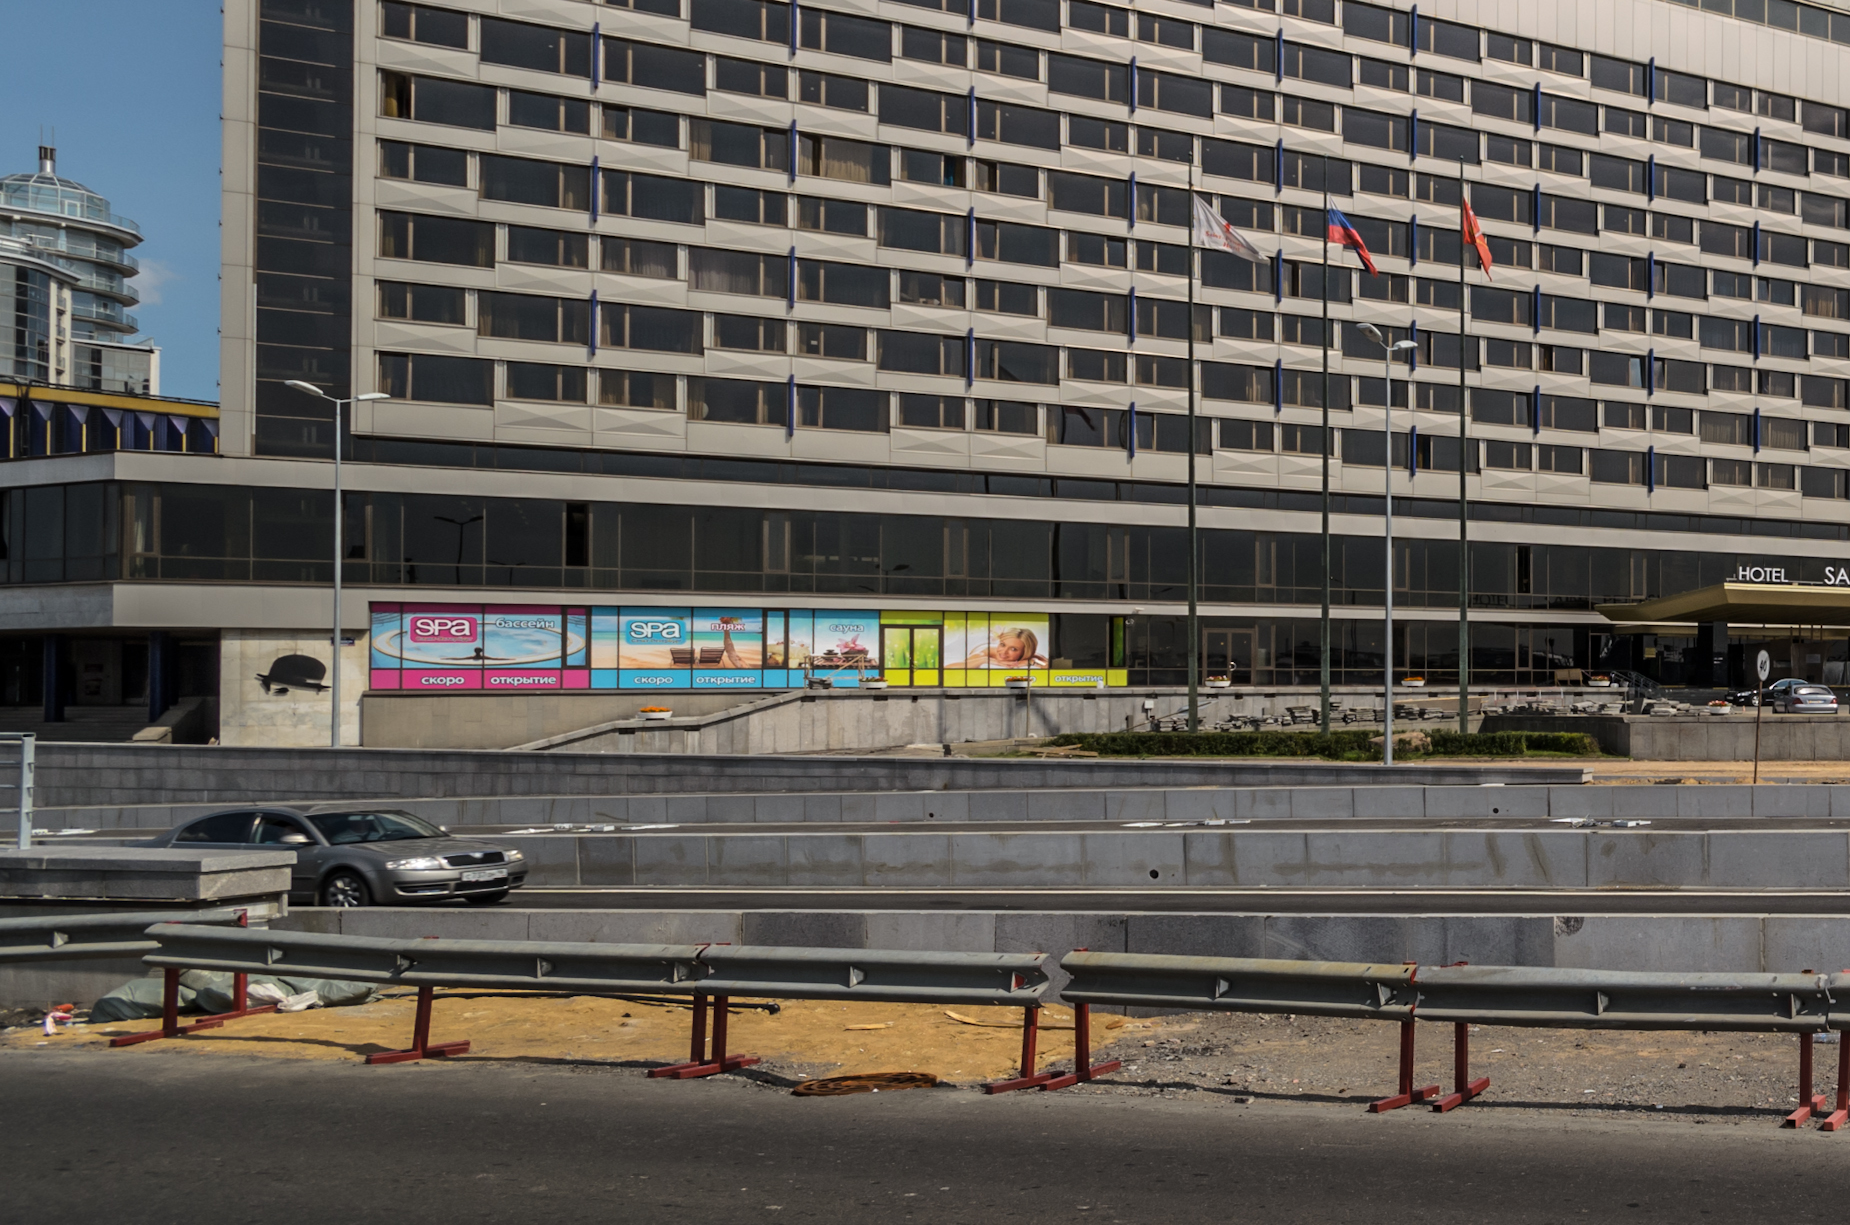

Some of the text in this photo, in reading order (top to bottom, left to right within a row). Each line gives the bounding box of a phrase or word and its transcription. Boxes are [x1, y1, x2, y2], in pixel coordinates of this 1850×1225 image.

[1738, 567, 1789, 583] HOTEL
[495, 618, 555, 628] бассейн
[711, 623, 745, 631] пляж
[829, 624, 865, 634] сауна
[1760, 659, 1768, 673] 40
[421, 676, 557, 686] скоро открытие
[633, 676, 756, 685] скоро открытие
[1055, 675, 1104, 684] открытие
